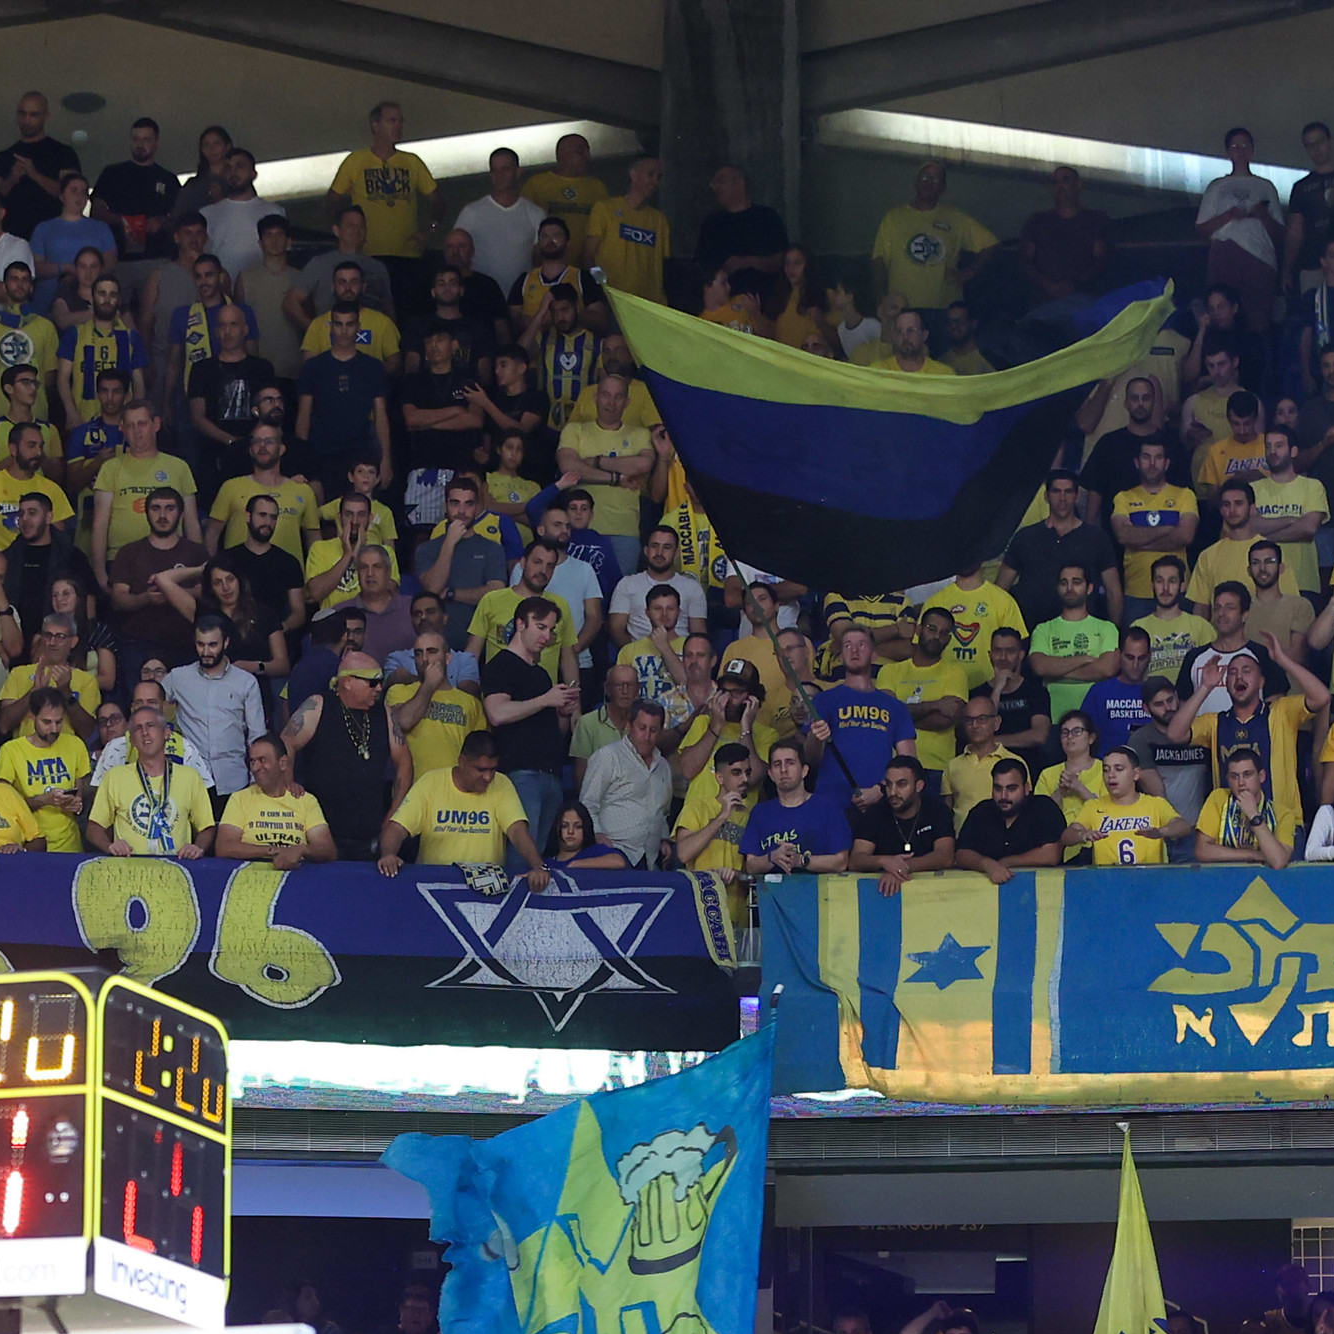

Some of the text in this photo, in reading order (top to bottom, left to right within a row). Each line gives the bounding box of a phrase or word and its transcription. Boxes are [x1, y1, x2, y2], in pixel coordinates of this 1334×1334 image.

[837, 706, 891, 723] UM96
[436, 810, 490, 825] UM96
[1099, 815, 1151, 832] LAKERS
[254, 833, 302, 845] ULTRAS
[1118, 839, 1135, 865] 6
[70, 857, 342, 1009] 96
